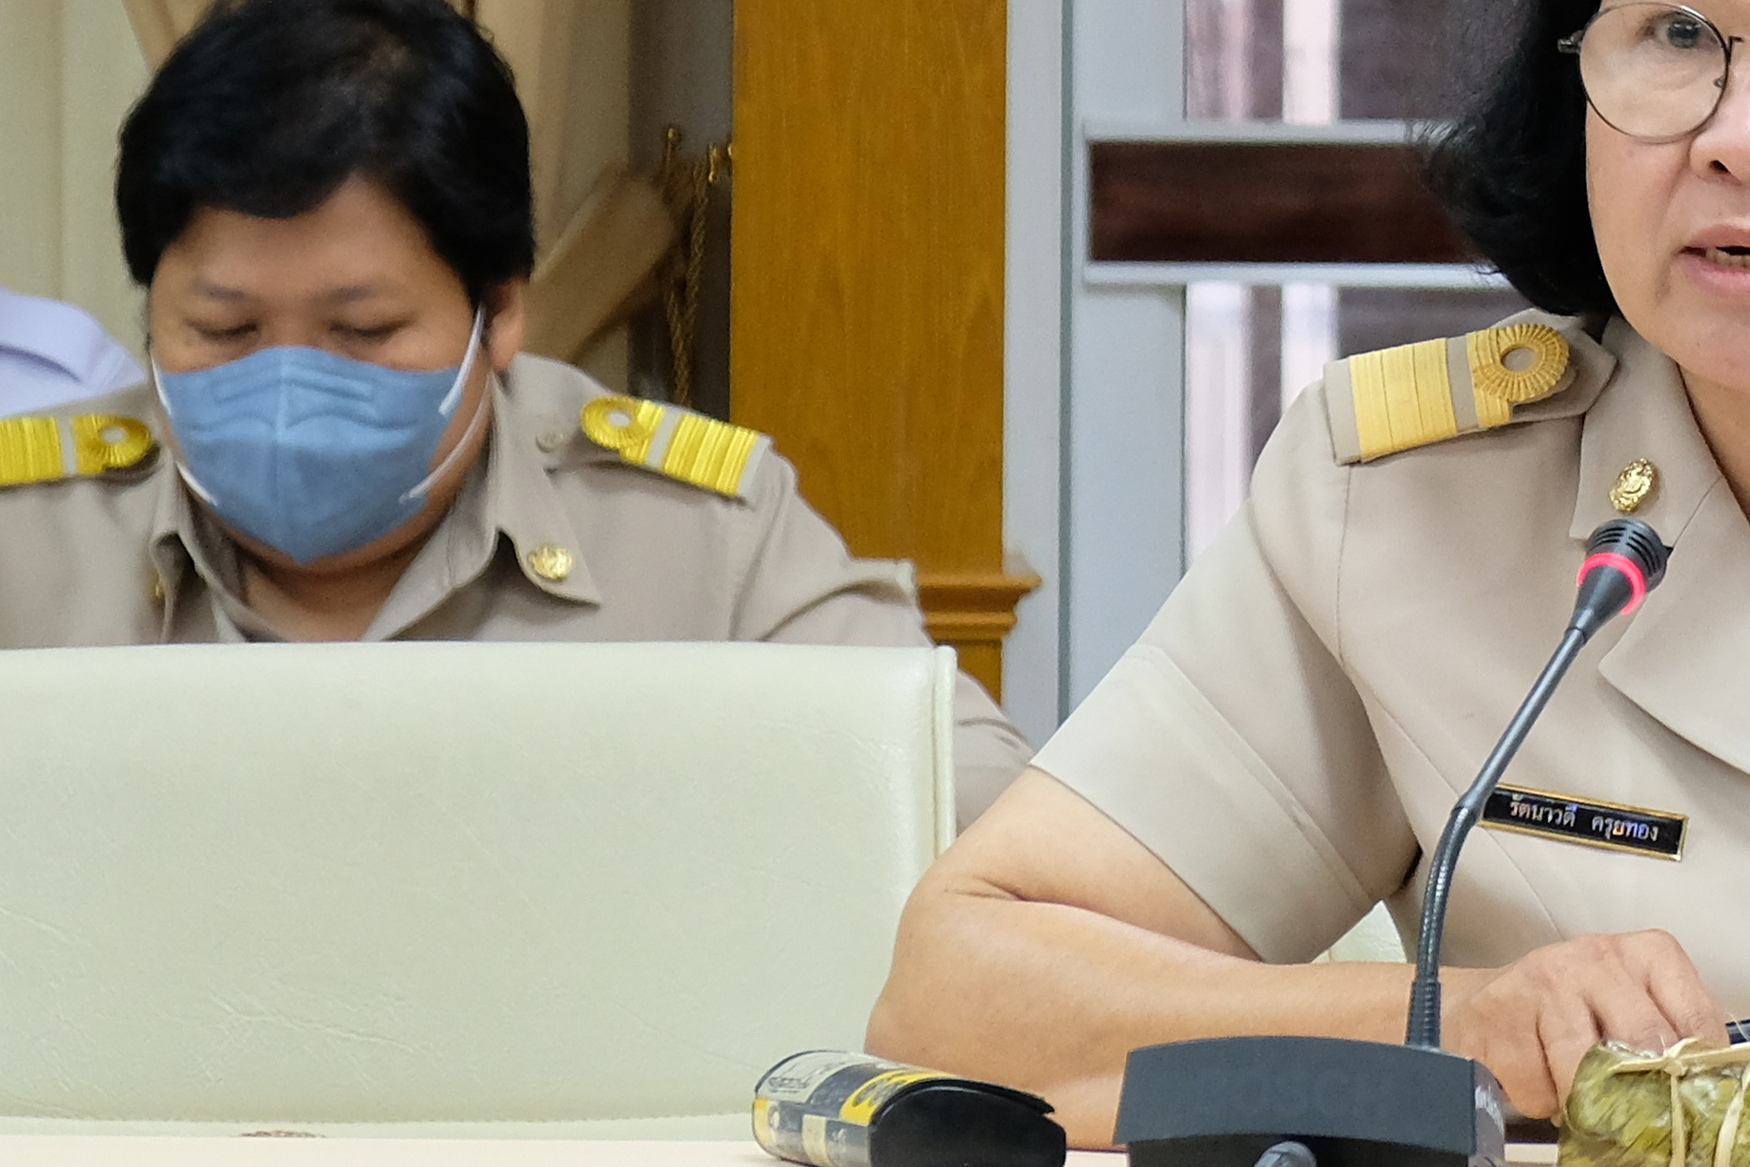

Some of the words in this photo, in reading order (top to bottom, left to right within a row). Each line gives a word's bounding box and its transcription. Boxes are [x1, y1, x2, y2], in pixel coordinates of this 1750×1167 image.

[1510, 793, 1579, 827] รัตนาวดี
[1591, 815, 1659, 842] ครุยทอง
